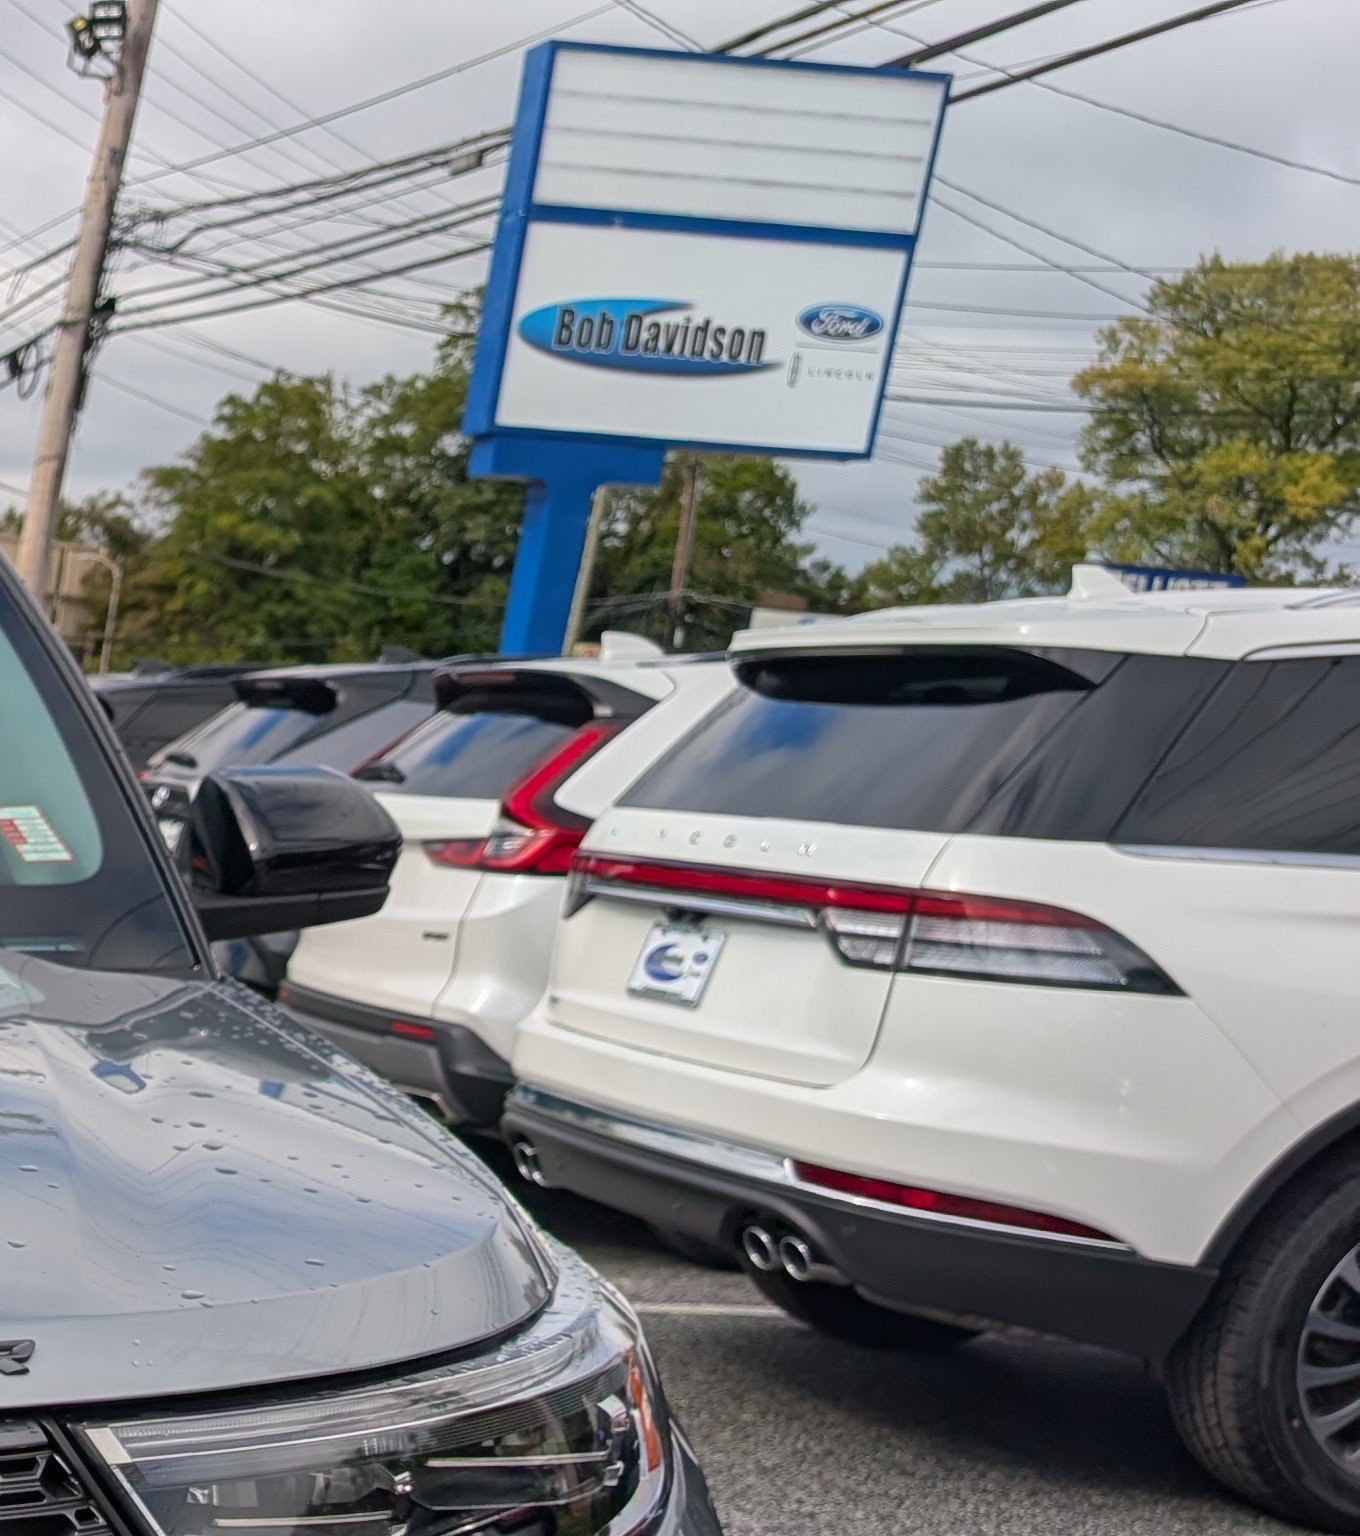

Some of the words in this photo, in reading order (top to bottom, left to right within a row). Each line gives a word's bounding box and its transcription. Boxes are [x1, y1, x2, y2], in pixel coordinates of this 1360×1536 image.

[554, 306, 615, 352] Bob
[622, 312, 767, 364] Davidson
[810, 307, 871, 337] Ford
